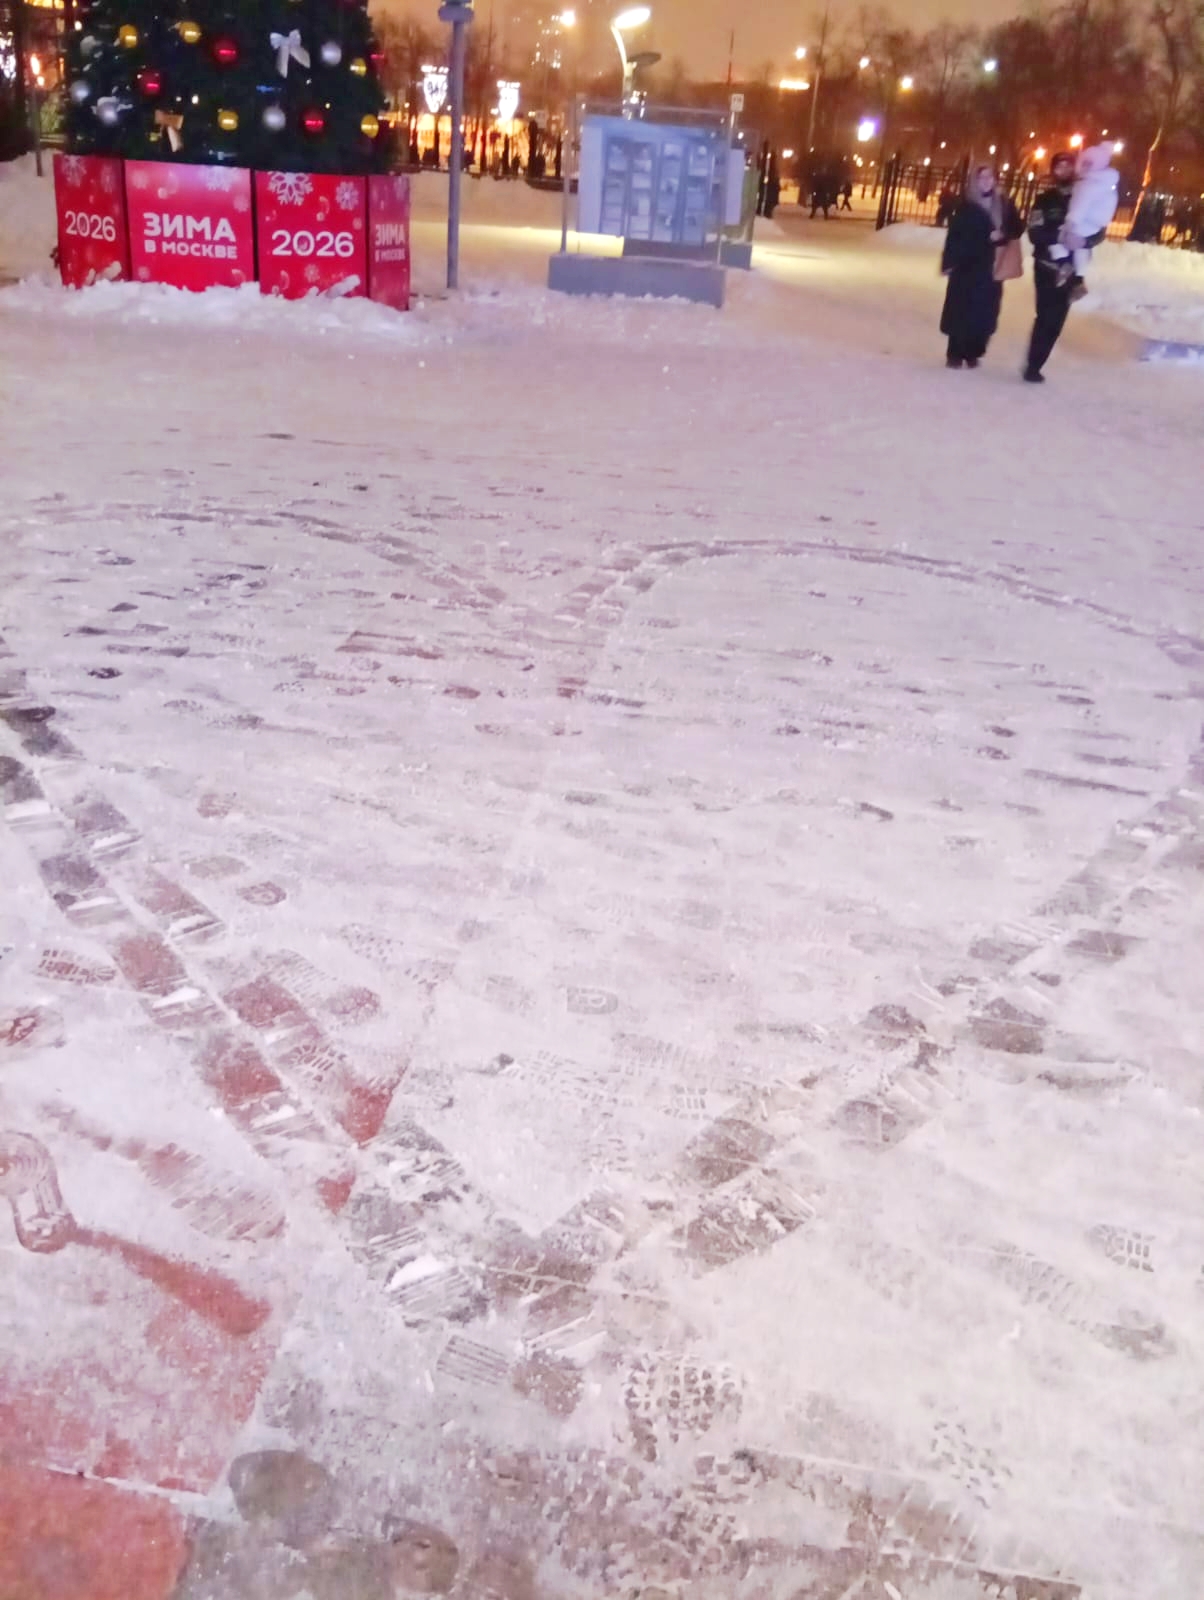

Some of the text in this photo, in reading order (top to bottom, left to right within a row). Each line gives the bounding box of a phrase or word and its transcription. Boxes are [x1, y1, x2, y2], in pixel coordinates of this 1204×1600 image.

[65, 211, 116, 242] 2026
[143, 212, 236, 242] ЗИМА
[145, 240, 238, 260] В МОСКВЕ
[272, 230, 354, 258] 2026
